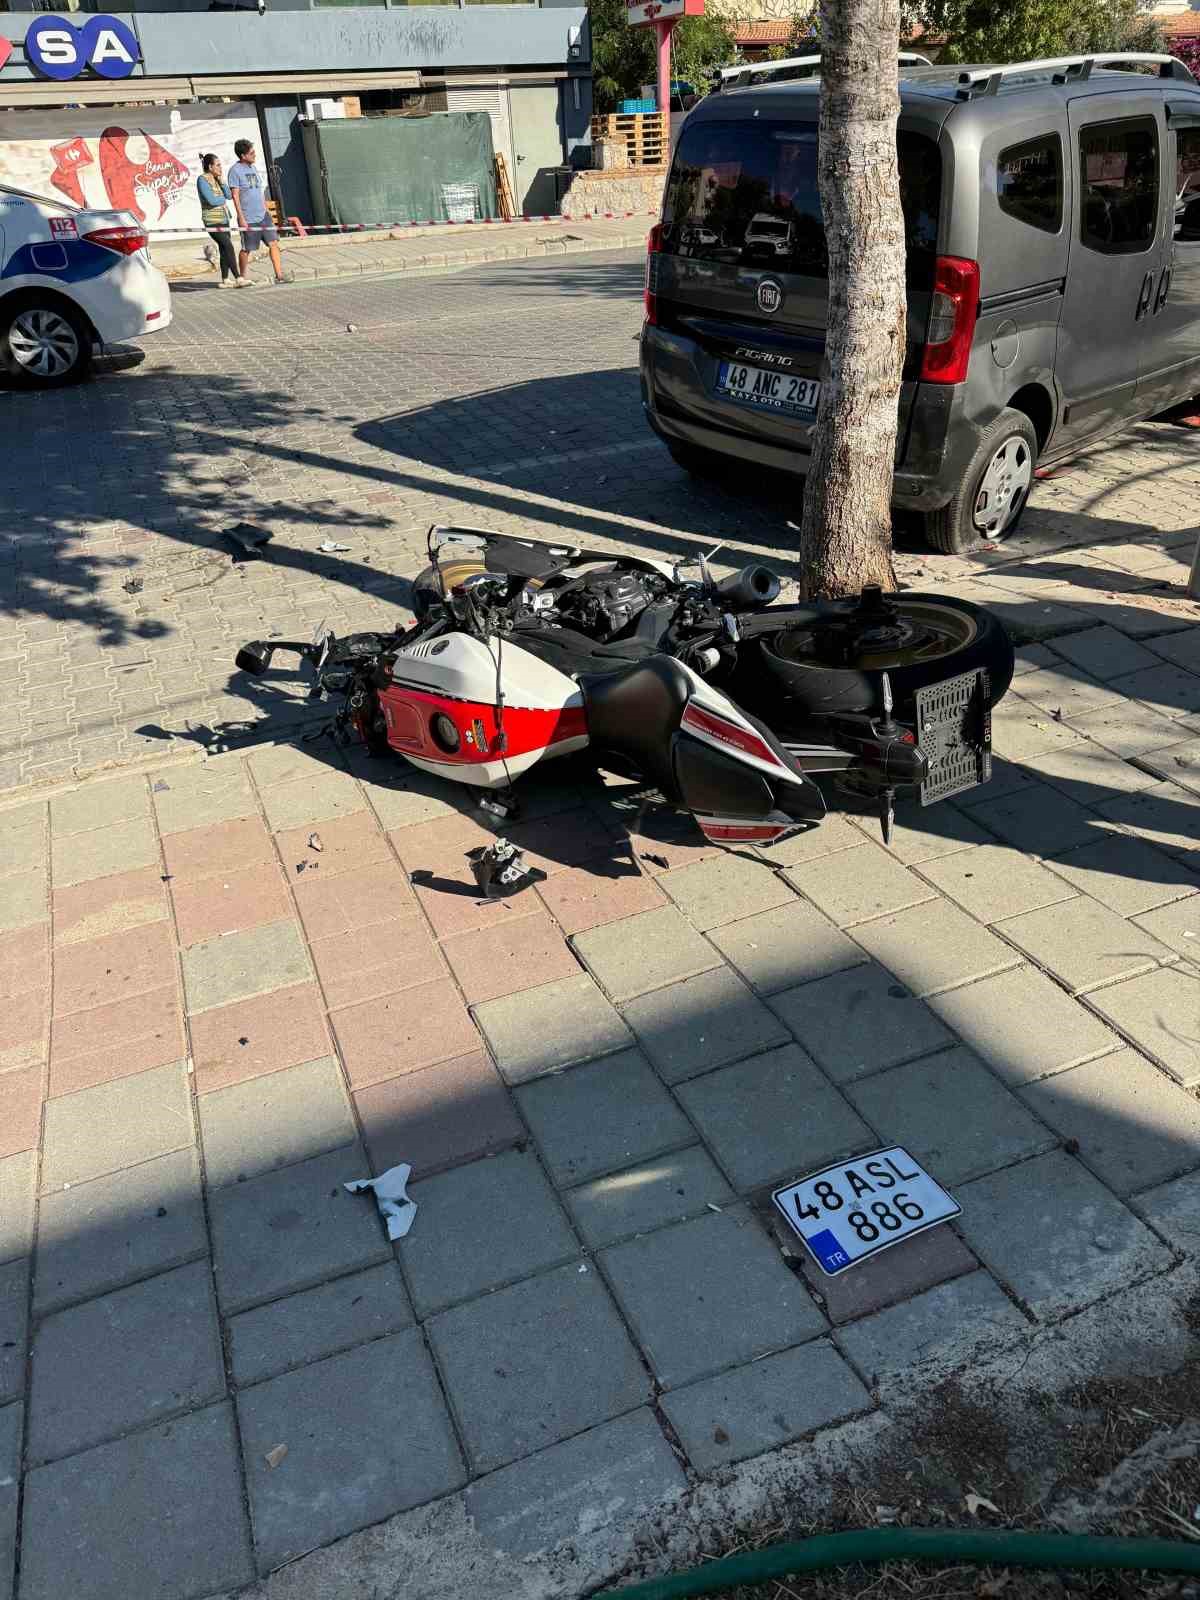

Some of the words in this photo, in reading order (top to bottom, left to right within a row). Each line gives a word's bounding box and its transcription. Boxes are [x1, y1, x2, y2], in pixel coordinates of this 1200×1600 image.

[52, 218, 75, 231] 112
[762, 289, 777, 304] FIAT
[729, 366, 748, 389] 48
[752, 371, 781, 397] ANC
[786, 379, 817, 405] 281
[760, 397, 782, 407] OTO
[794, 1181, 844, 1219] 48
[844, 1157, 920, 1198] ASL
[847, 1193, 924, 1242] 886
[826, 1252, 846, 1266] TR
